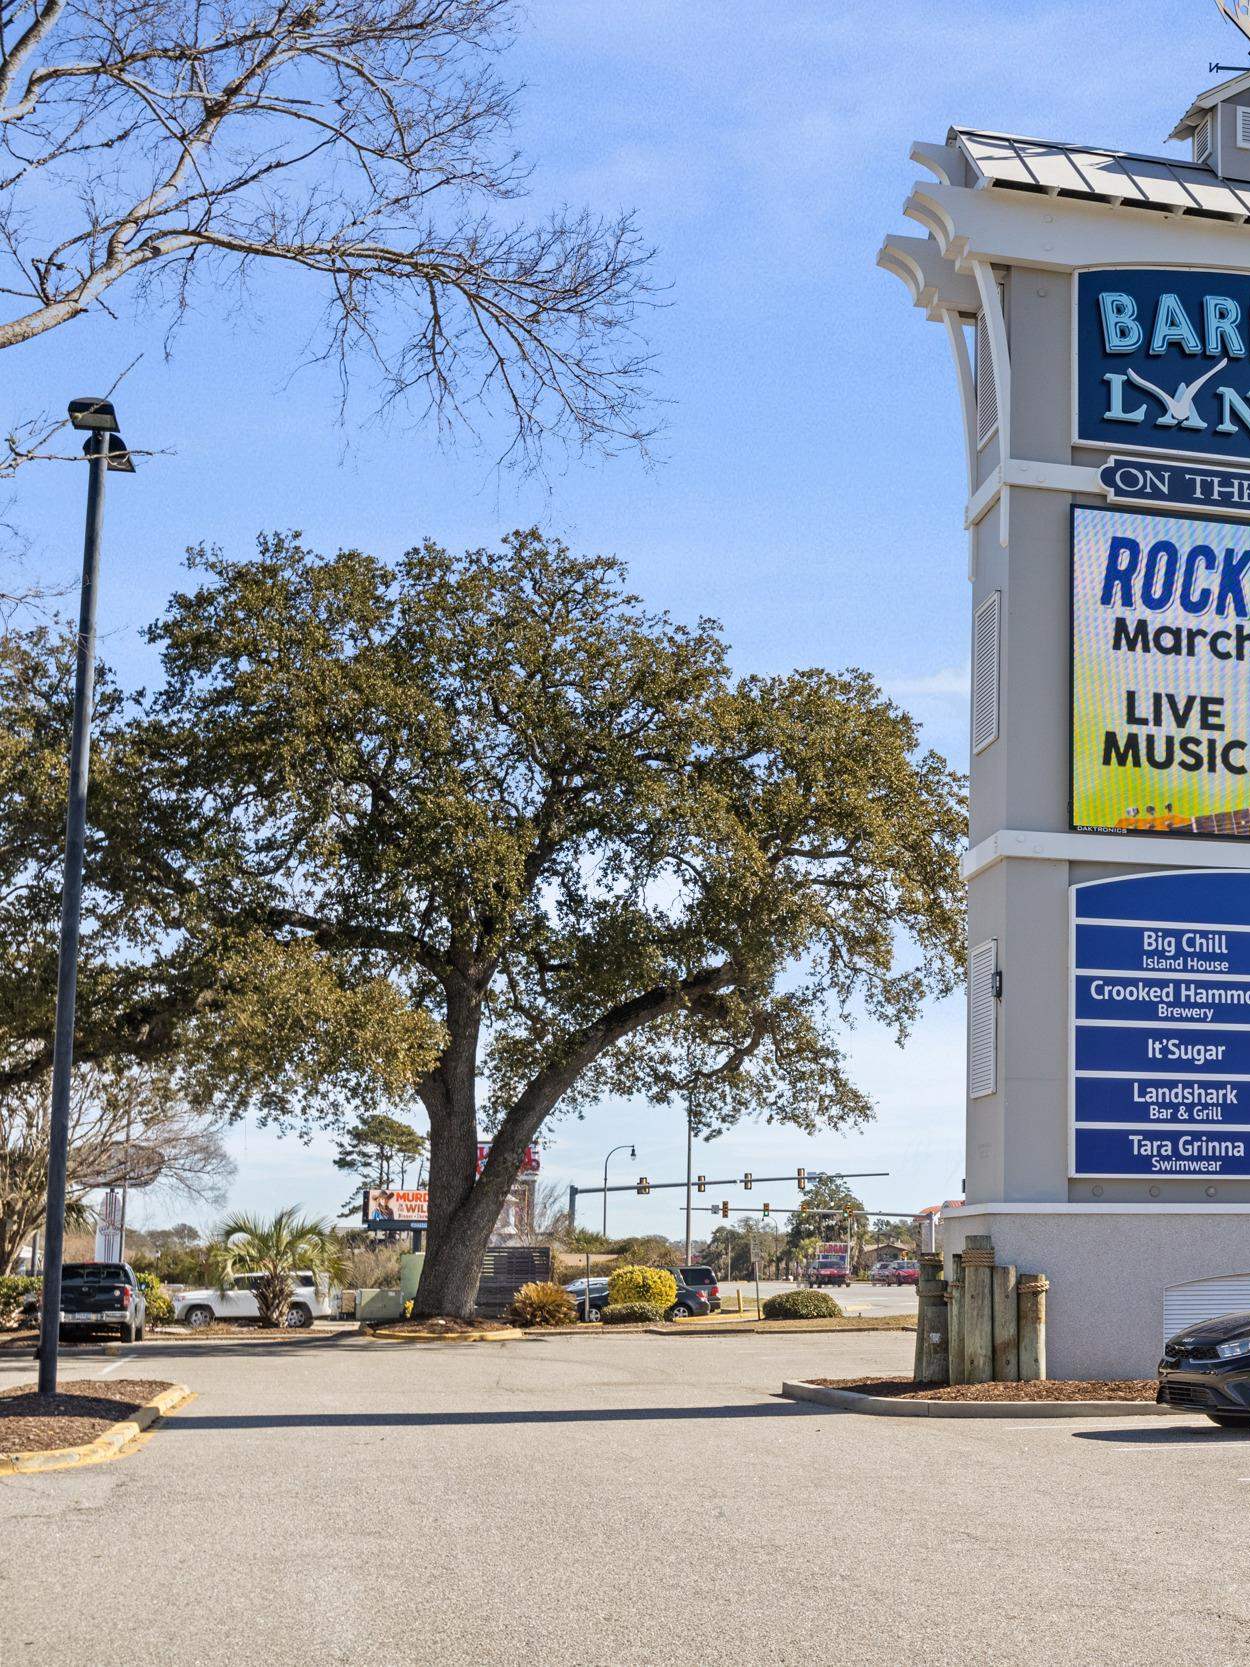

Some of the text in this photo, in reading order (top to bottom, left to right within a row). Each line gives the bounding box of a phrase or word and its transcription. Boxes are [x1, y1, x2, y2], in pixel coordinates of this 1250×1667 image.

[1115, 467, 1171, 495] ON
[1125, 690, 1226, 732] LIVE
[1102, 731, 1248, 775] MUSIC
[1077, 825, 1128, 834] DAKTRONICS
[1144, 932, 1228, 955] Big Chill
[1143, 956, 1228, 971] Island House
[1091, 981, 1173, 1002] Crooked
[1158, 1004, 1213, 1022] Brewery
[1149, 1039, 1225, 1064] It'Sugar
[1134, 1083, 1237, 1103] Landshark
[1150, 1106, 1222, 1120] Bar & Grill
[1129, 1136, 1244, 1156] Tara Grinna
[1152, 1157, 1222, 1171] Swimwear
